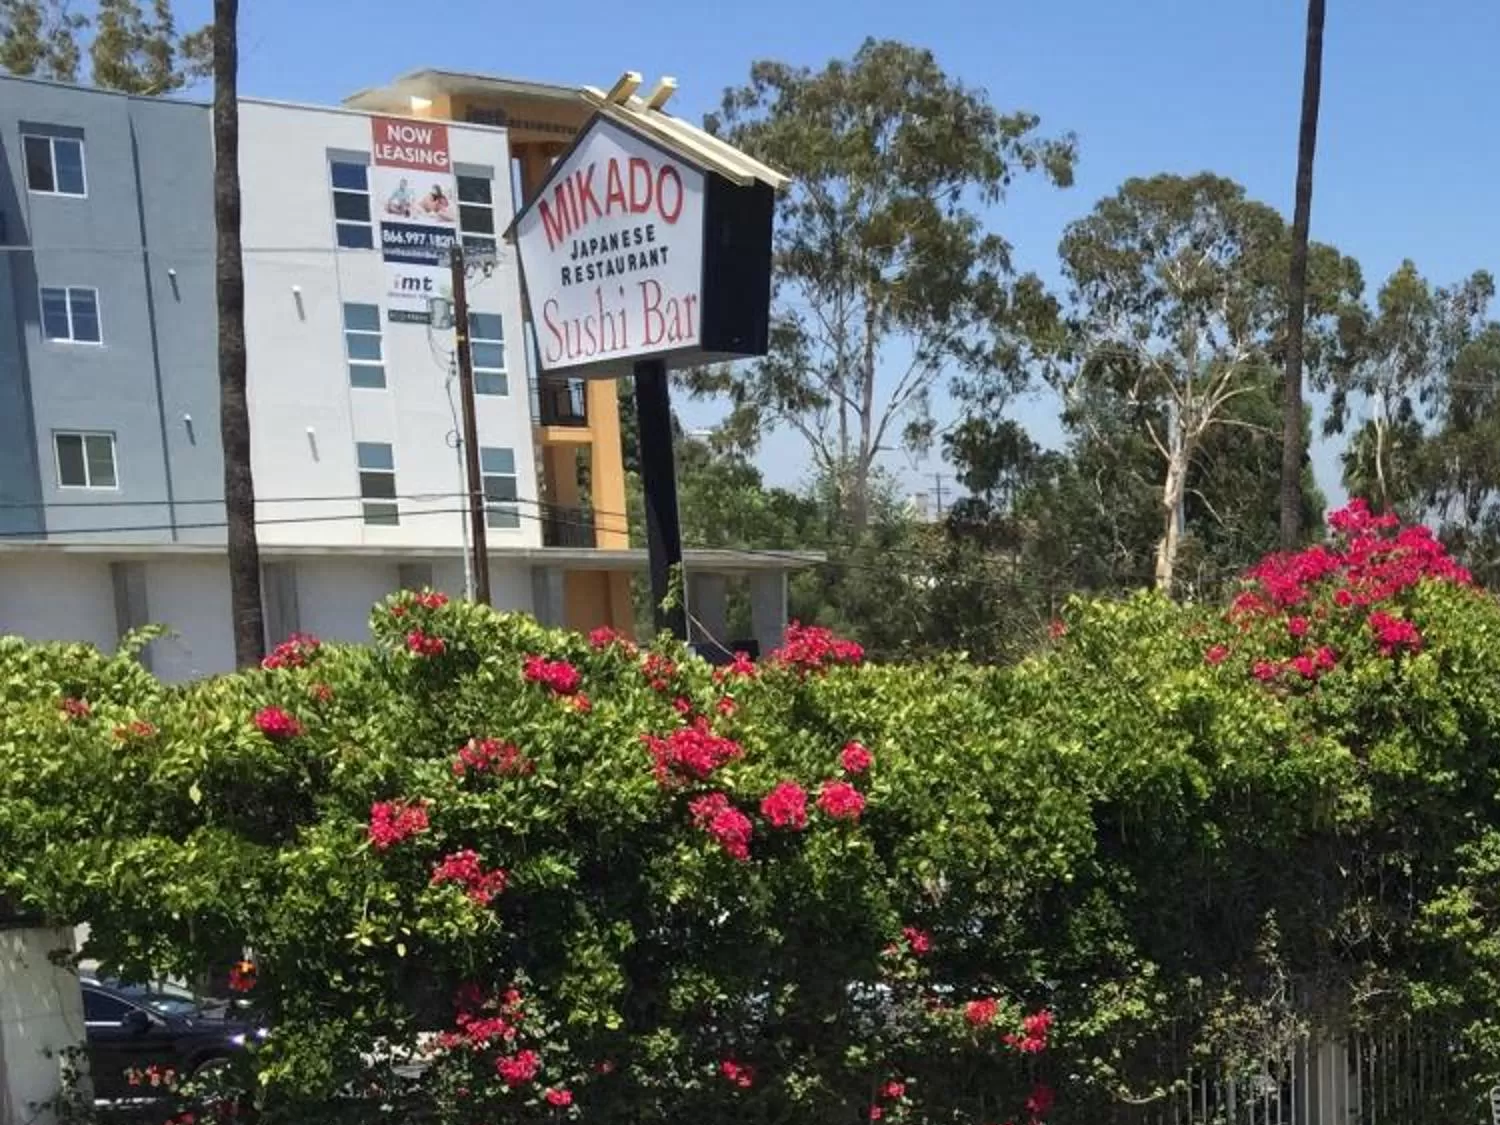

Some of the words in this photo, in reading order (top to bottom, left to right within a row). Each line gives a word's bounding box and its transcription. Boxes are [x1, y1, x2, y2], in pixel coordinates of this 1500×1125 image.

[386, 124, 433, 145] NOW
[375, 143, 449, 167] LEASING
[538, 157, 684, 253] MIKADO
[570, 223, 656, 261] JAPANESE
[560, 245, 669, 287] RESTAURANT
[543, 285, 629, 363] Sushi
[638, 278, 697, 347] Bar
